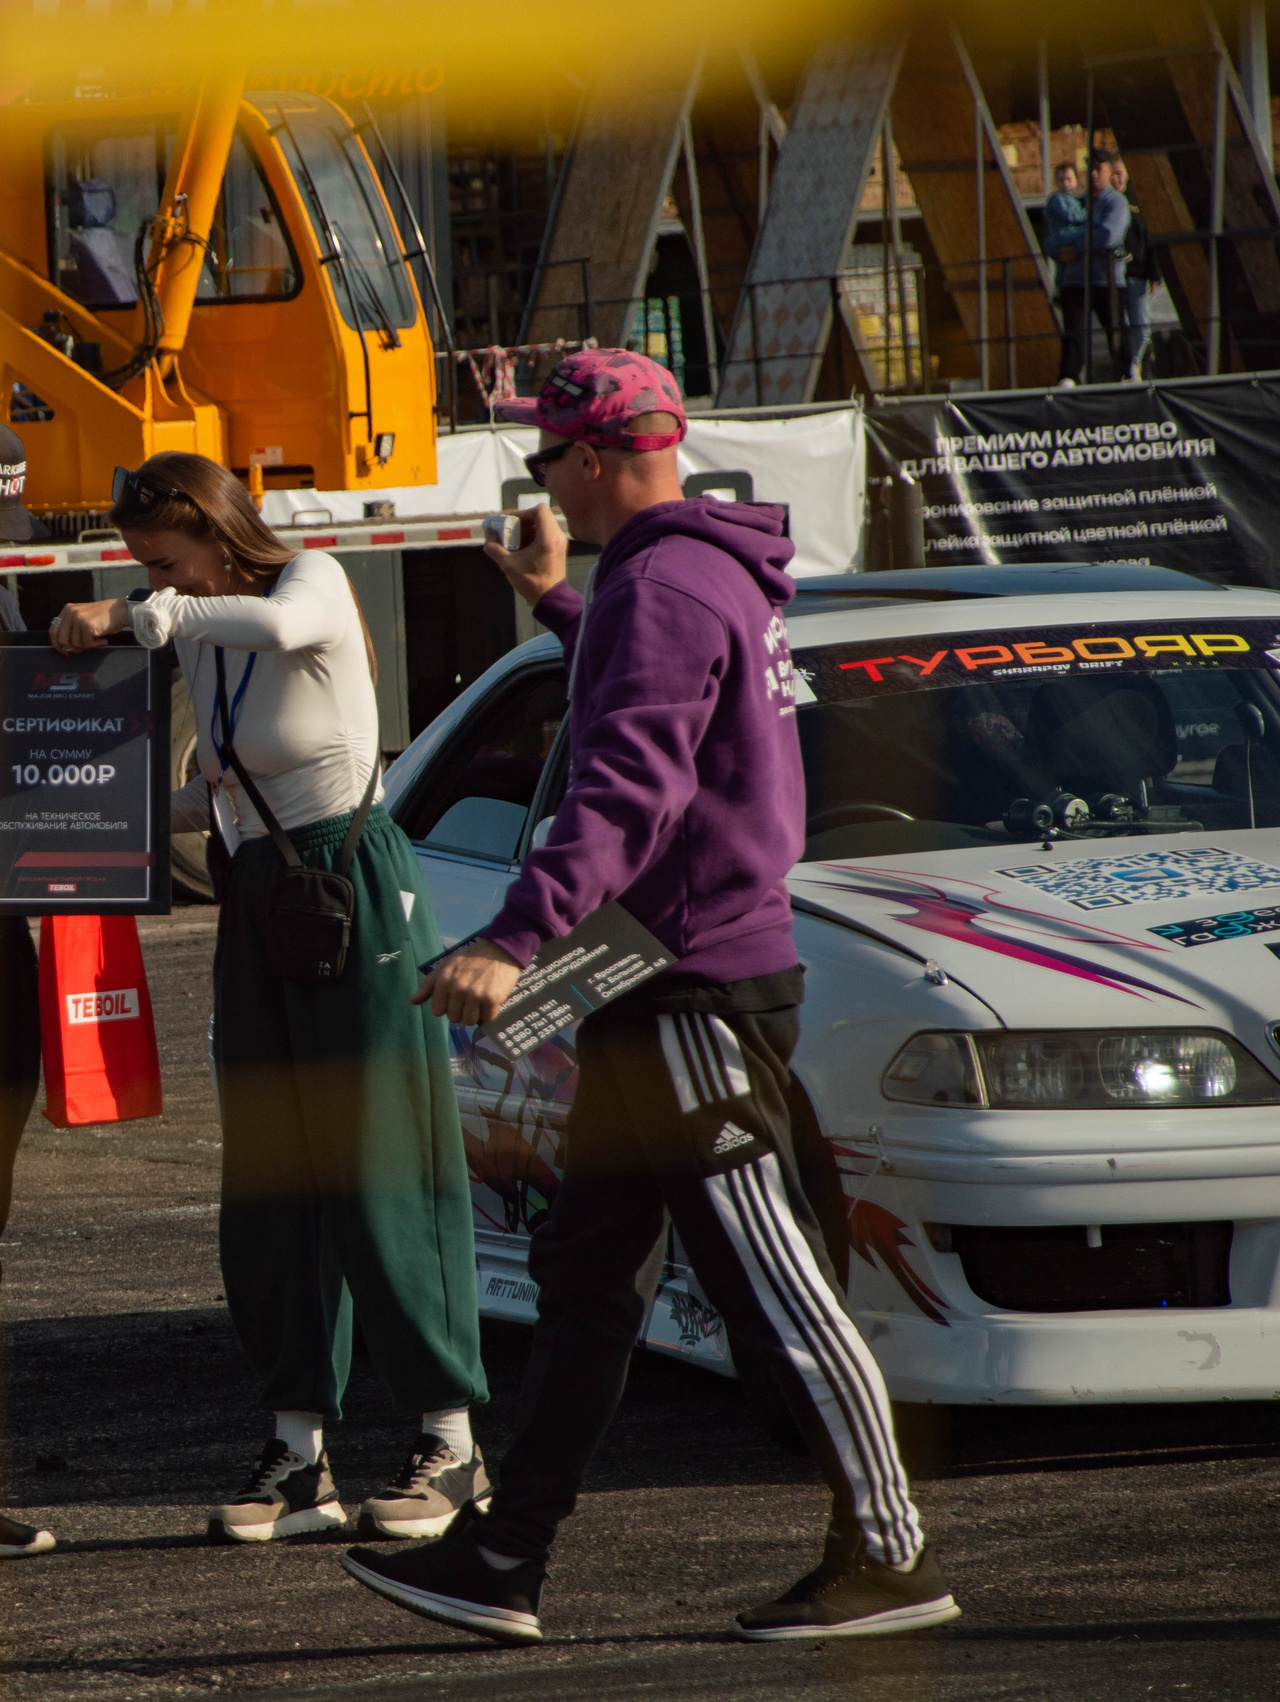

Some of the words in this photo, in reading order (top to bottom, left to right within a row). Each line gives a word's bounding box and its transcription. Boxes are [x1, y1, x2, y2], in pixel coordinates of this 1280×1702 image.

[936, 429, 1053, 455] ПРЕМИУМ
[1056, 421, 1178, 447] КАЧЕСТВО
[954, 449, 1048, 474] ВАШЕГО
[1051, 438, 1217, 467] АВТОМОБИЛЯ
[1041, 488, 1136, 512] защитной
[1138, 481, 1218, 504] плёнкой
[1074, 520, 1149, 543] цветной
[1150, 514, 1228, 536] плёнкой
[839, 634, 1251, 682] ТУРБОЯР
[992, 663, 1071, 677] SHARAPOV
[1078, 660, 1124, 669] DRIFT
[2, 717, 124, 732] СЕРТИФИКАТ
[30, 749, 47, 759] НА
[51, 749, 92, 760] СУММУ
[26, 812, 38, 820] НА
[40, 812, 101, 820] ТЕХНИЧЕСКОЕ
[70, 821, 128, 830] АВТОМОБИЛЯ
[498, 989, 530, 1013] АНОВКА
[529, 979, 548, 993] ДОП
[547, 943, 609, 982] ОБОРУДОВАНИЯ
[518, 946, 586, 987] КОНДИЦИОНЕРОВ
[593, 953, 642, 979] Ярославль,
[594, 982, 609, 993] ул.
[607, 960, 646, 984] Большая
[601, 966, 654, 998] Октябрьская
[70, 992, 133, 1020] TEBOIL
[498, 1031, 507, 1040] 8
[523, 1011, 540, 1022] 114
[538, 999, 559, 1012] 1411
[530, 1017, 549, 1030] 741
[546, 1004, 571, 1020] 7664
[537, 1024, 556, 1038] 233
[555, 1013, 574, 1027] 9111
[713, 1132, 755, 1155] adidas
